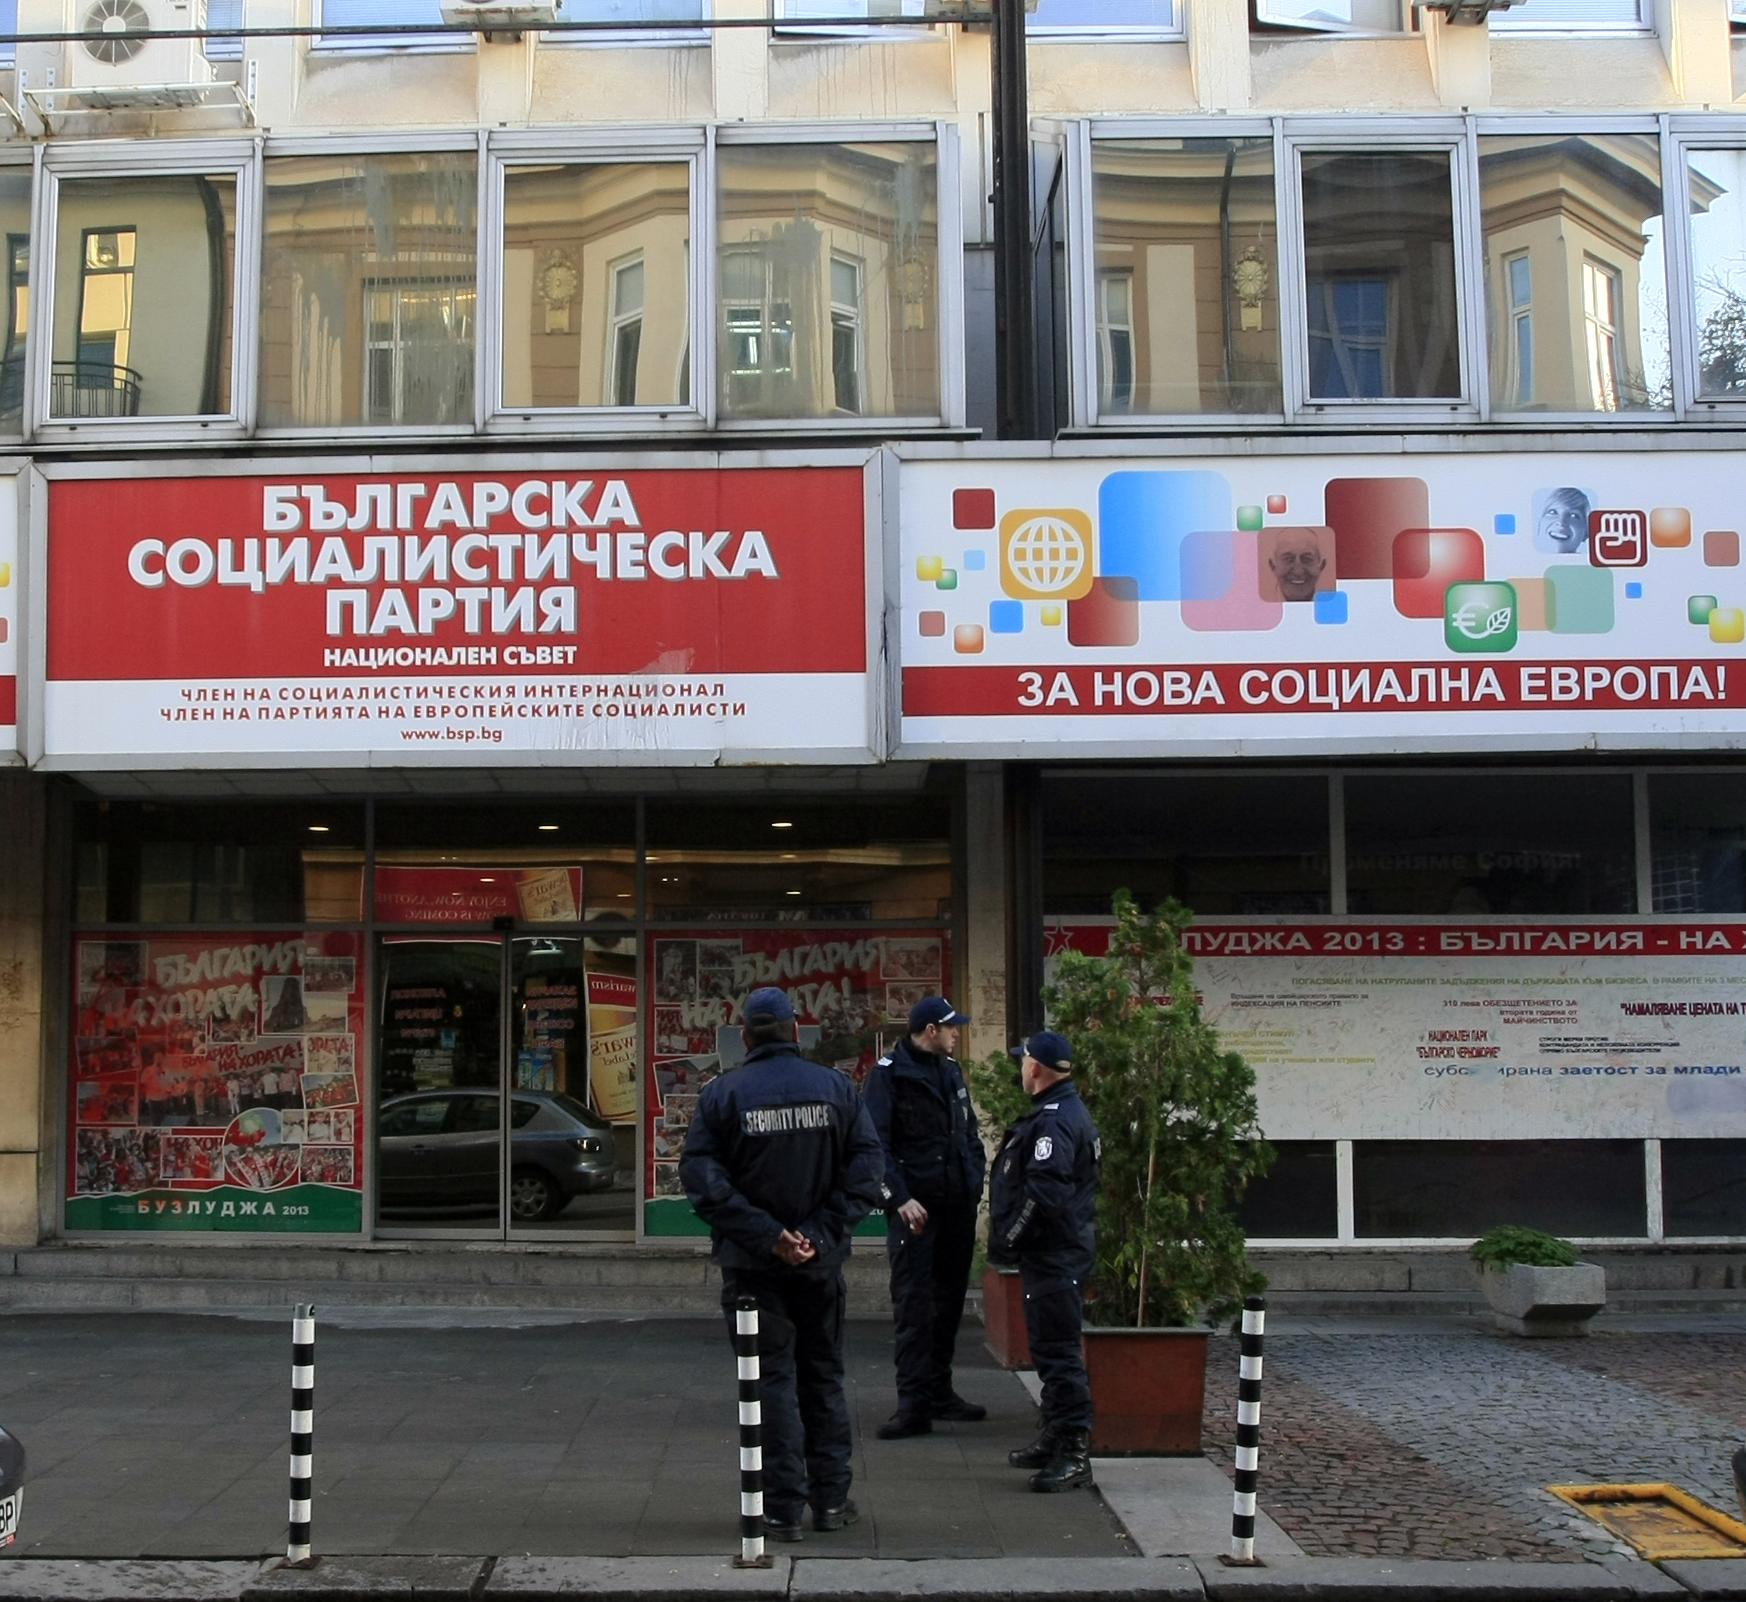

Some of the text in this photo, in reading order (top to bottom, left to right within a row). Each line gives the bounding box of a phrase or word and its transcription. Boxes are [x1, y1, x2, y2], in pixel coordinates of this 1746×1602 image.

[263, 480, 641, 531] БЪЛГАРСКА
[127, 531, 779, 593] СОЦИАЛИСТИЧЕСКА
[326, 586, 577, 636] ПАРТИЯ
[324, 645, 577, 669] НАЦИОНАЛЕН СЪВЕТ
[180, 683, 725, 703] ЧЛЕН НА СОЦИАЛИСТИЧЕСКИЯ ИНТЕРНАЦИОНАЛ
[1017, 665, 1727, 710] ЗА НОВА СОЦИАЛНА ЕВРОПА!
[160, 701, 747, 721] ЧЛЕН НА ПАРТИЯТА НА ЕВРОПЕЙСКИТЕ СОЦИАЛИСТИ
[401, 726, 502, 743] www.bsp.bg
[1323, 932, 1404, 951] 2013
[1440, 930, 1644, 951] БЪЛГАРИЯ
[1680, 930, 1732, 949] НА
[154, 939, 306, 988] БЪЛГАРИЯ
[731, 936, 889, 988] БЪЛГАРИЯ
[1355, 977, 1368, 985] НА
[1424, 1064, 1742, 1077] субсирана заетост за млади
[745, 1104, 829, 1133] SECURITY POLICE
[137, 1200, 276, 1218] БУЗЛУДЖА
[282, 1205, 310, 1216] 2013
